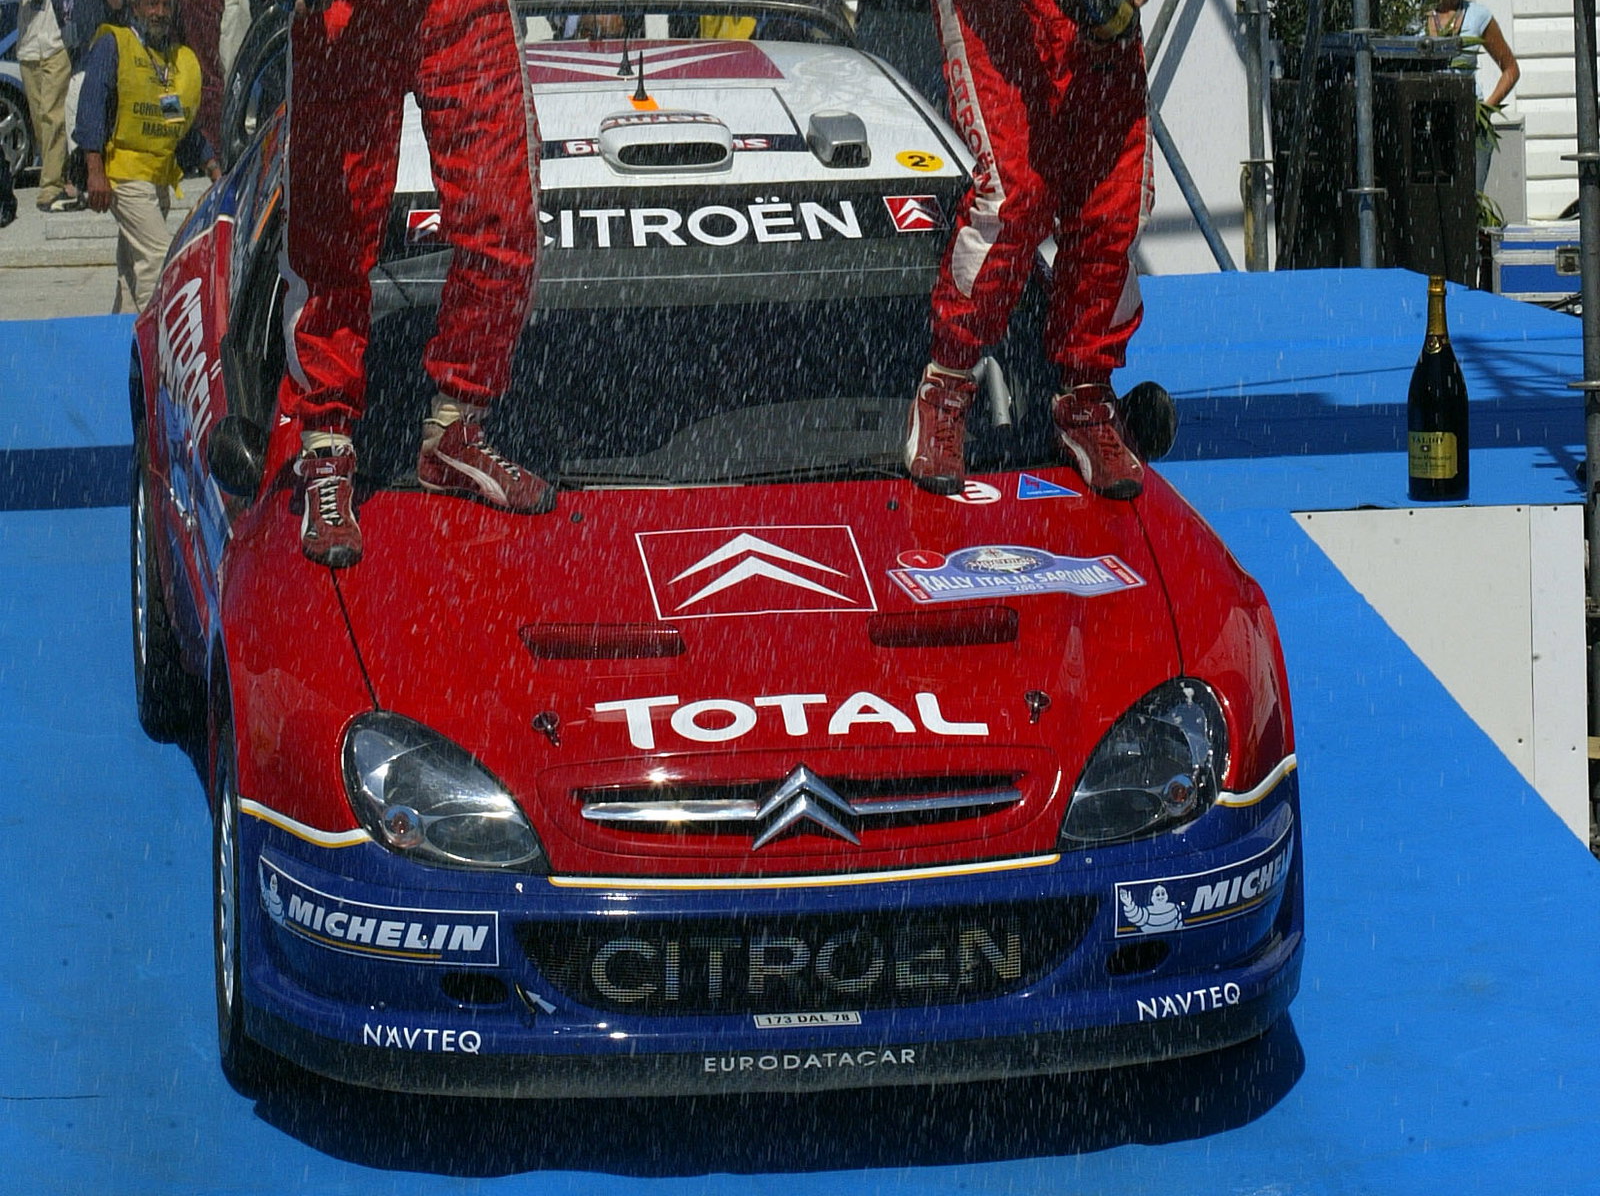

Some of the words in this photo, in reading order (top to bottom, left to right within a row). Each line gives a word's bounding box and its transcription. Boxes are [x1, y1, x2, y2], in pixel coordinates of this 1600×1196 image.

[914, 574, 974, 592] RALLY
[975, 576, 1034, 588] ITALIA
[1034, 565, 1116, 586] SARDINIA
[594, 690, 989, 750] TOTAL
[287, 894, 489, 951] MICHELIN
[1136, 982, 1241, 1021] NAVTEQ
[766, 1016, 792, 1025] 173
[798, 1014, 828, 1023] DAL
[363, 1023, 482, 1054] NAVTEQ
[704, 1049, 916, 1073] EURODATACAR
